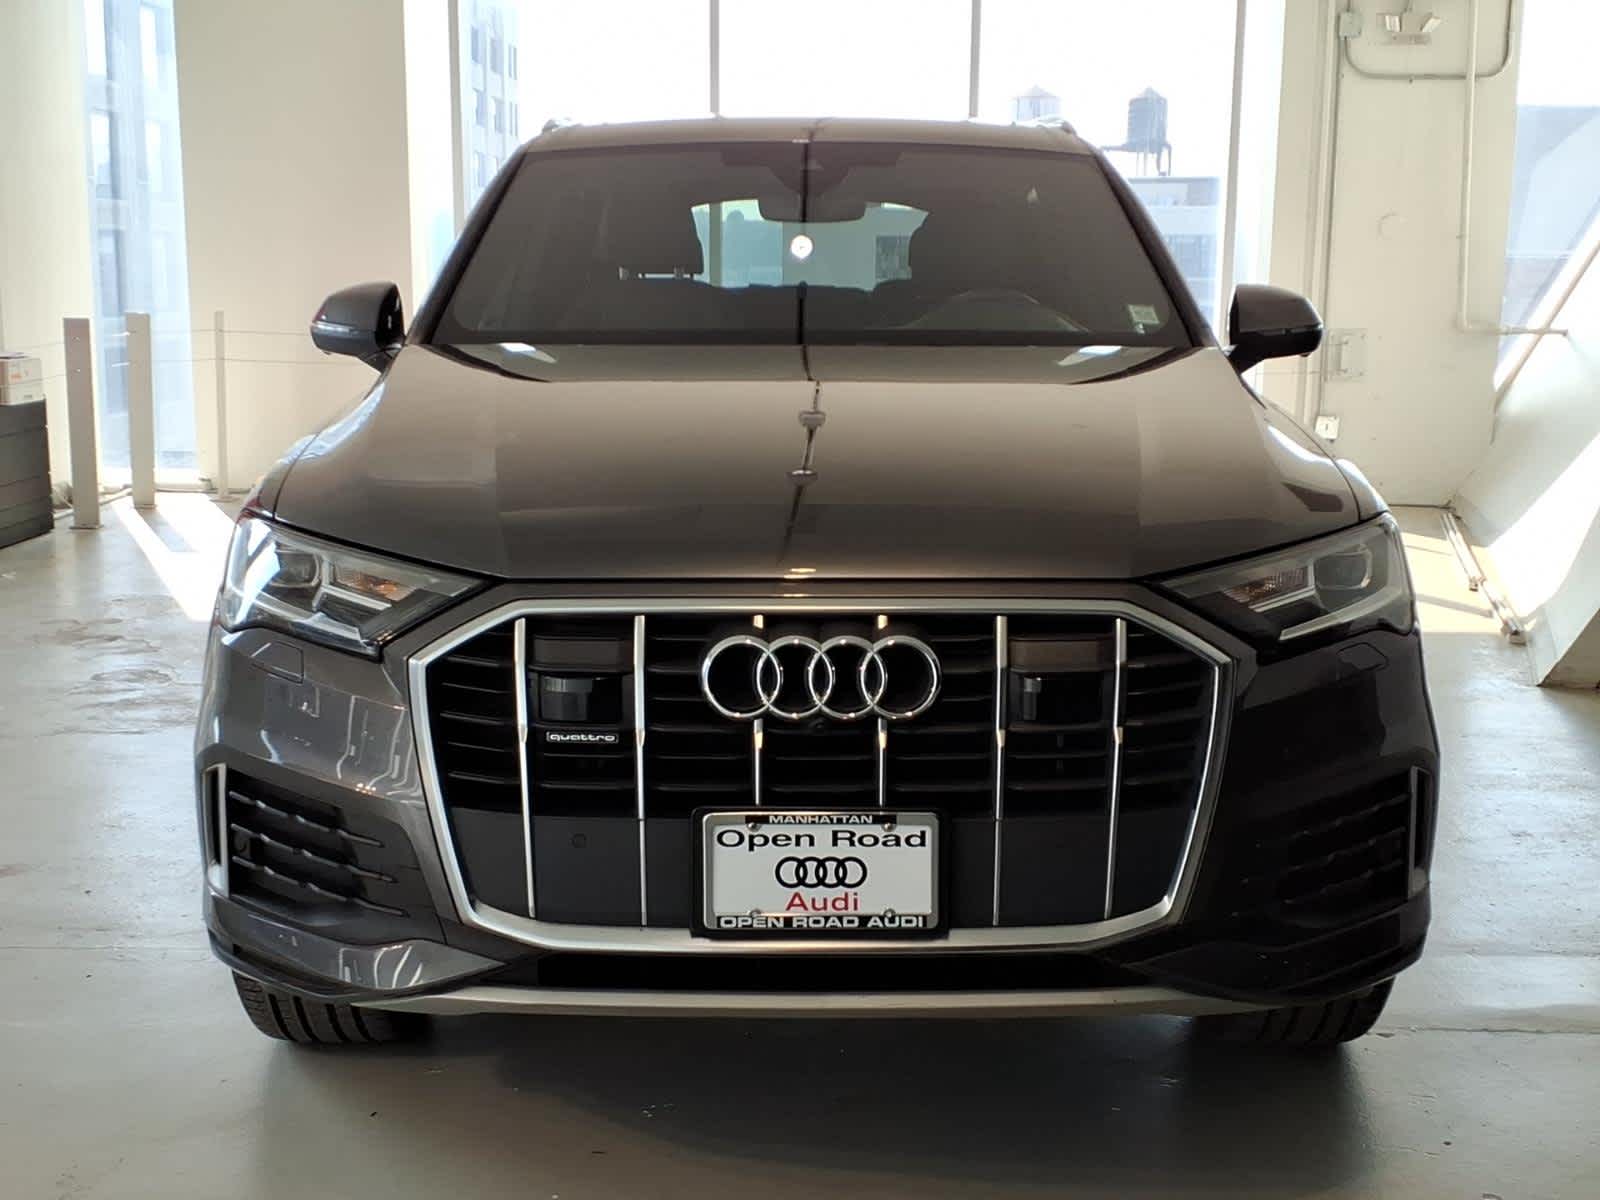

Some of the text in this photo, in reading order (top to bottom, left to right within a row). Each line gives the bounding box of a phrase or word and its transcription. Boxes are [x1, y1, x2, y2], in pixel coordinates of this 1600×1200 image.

[550, 733, 615, 742] quattro
[768, 815, 873, 825] MANHATTAN
[716, 829, 927, 852] Open Road
[785, 892, 861, 911] Audi
[719, 916, 924, 928] OPEN ROAD AUDI
